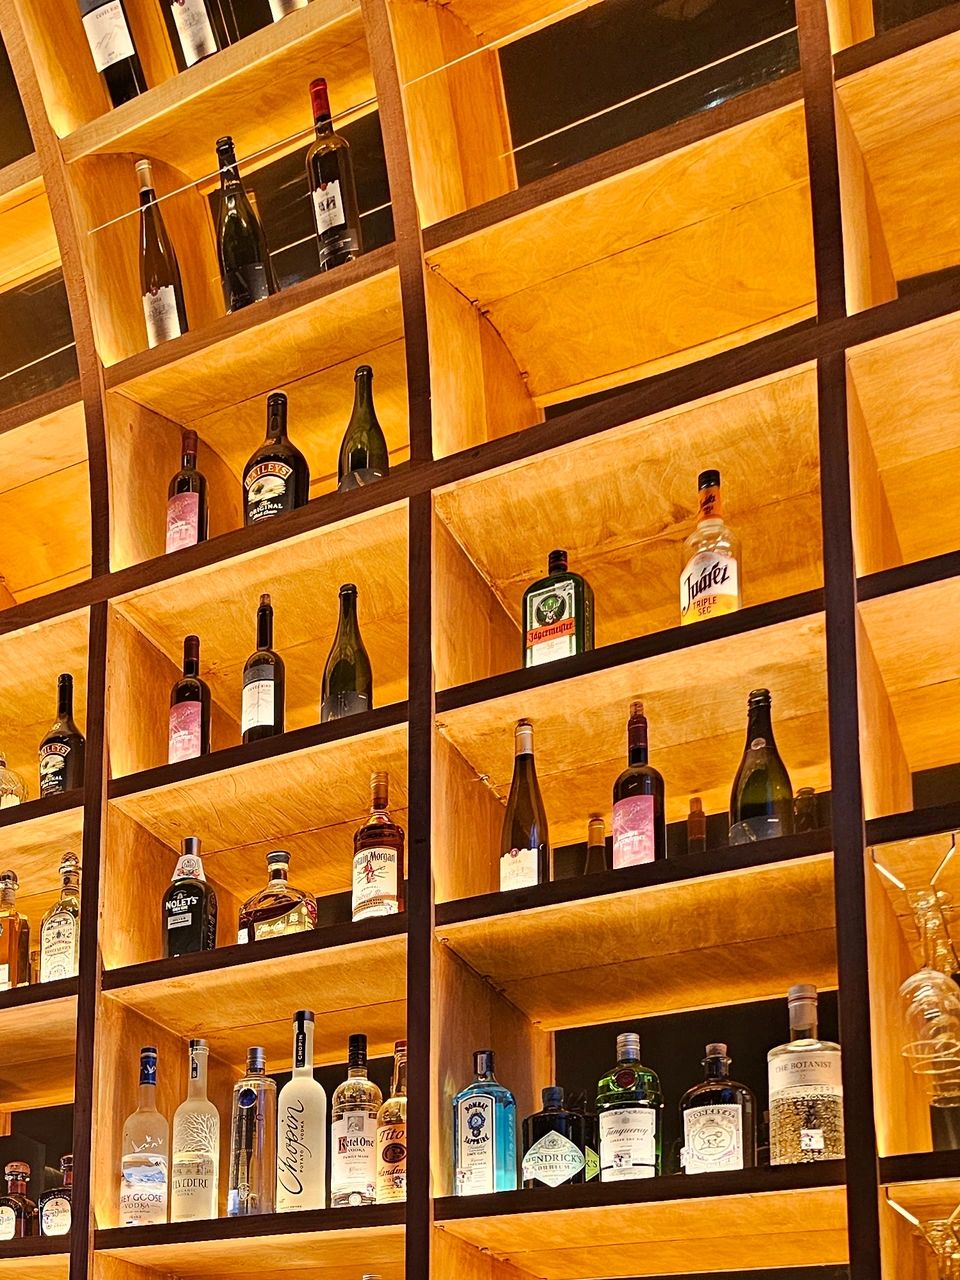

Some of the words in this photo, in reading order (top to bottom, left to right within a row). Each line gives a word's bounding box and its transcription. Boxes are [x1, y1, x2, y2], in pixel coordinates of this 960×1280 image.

[245, 463, 289, 488] BAILEYS
[249, 503, 283, 517] ORIGINAL
[682, 561, 730, 617] Juárez
[692, 596, 717, 610] TRIPLE
[698, 606, 712, 616] SEC
[44, 745, 66, 754] ILEYS
[370, 851, 395, 862] Morgan
[775, 1063, 789, 1073] THE
[790, 1061, 832, 1070] BOTANIST
[464, 1101, 489, 1114] BOMBAY
[606, 1126, 649, 1138] Tanqueray
[338, 1136, 359, 1154] Ketel
[360, 1137, 374, 1147] One
[464, 1133, 490, 1145] SAPPHIRE
[279, 1099, 312, 1195] Chopin
[133, 1193, 162, 1202] GOOSE
